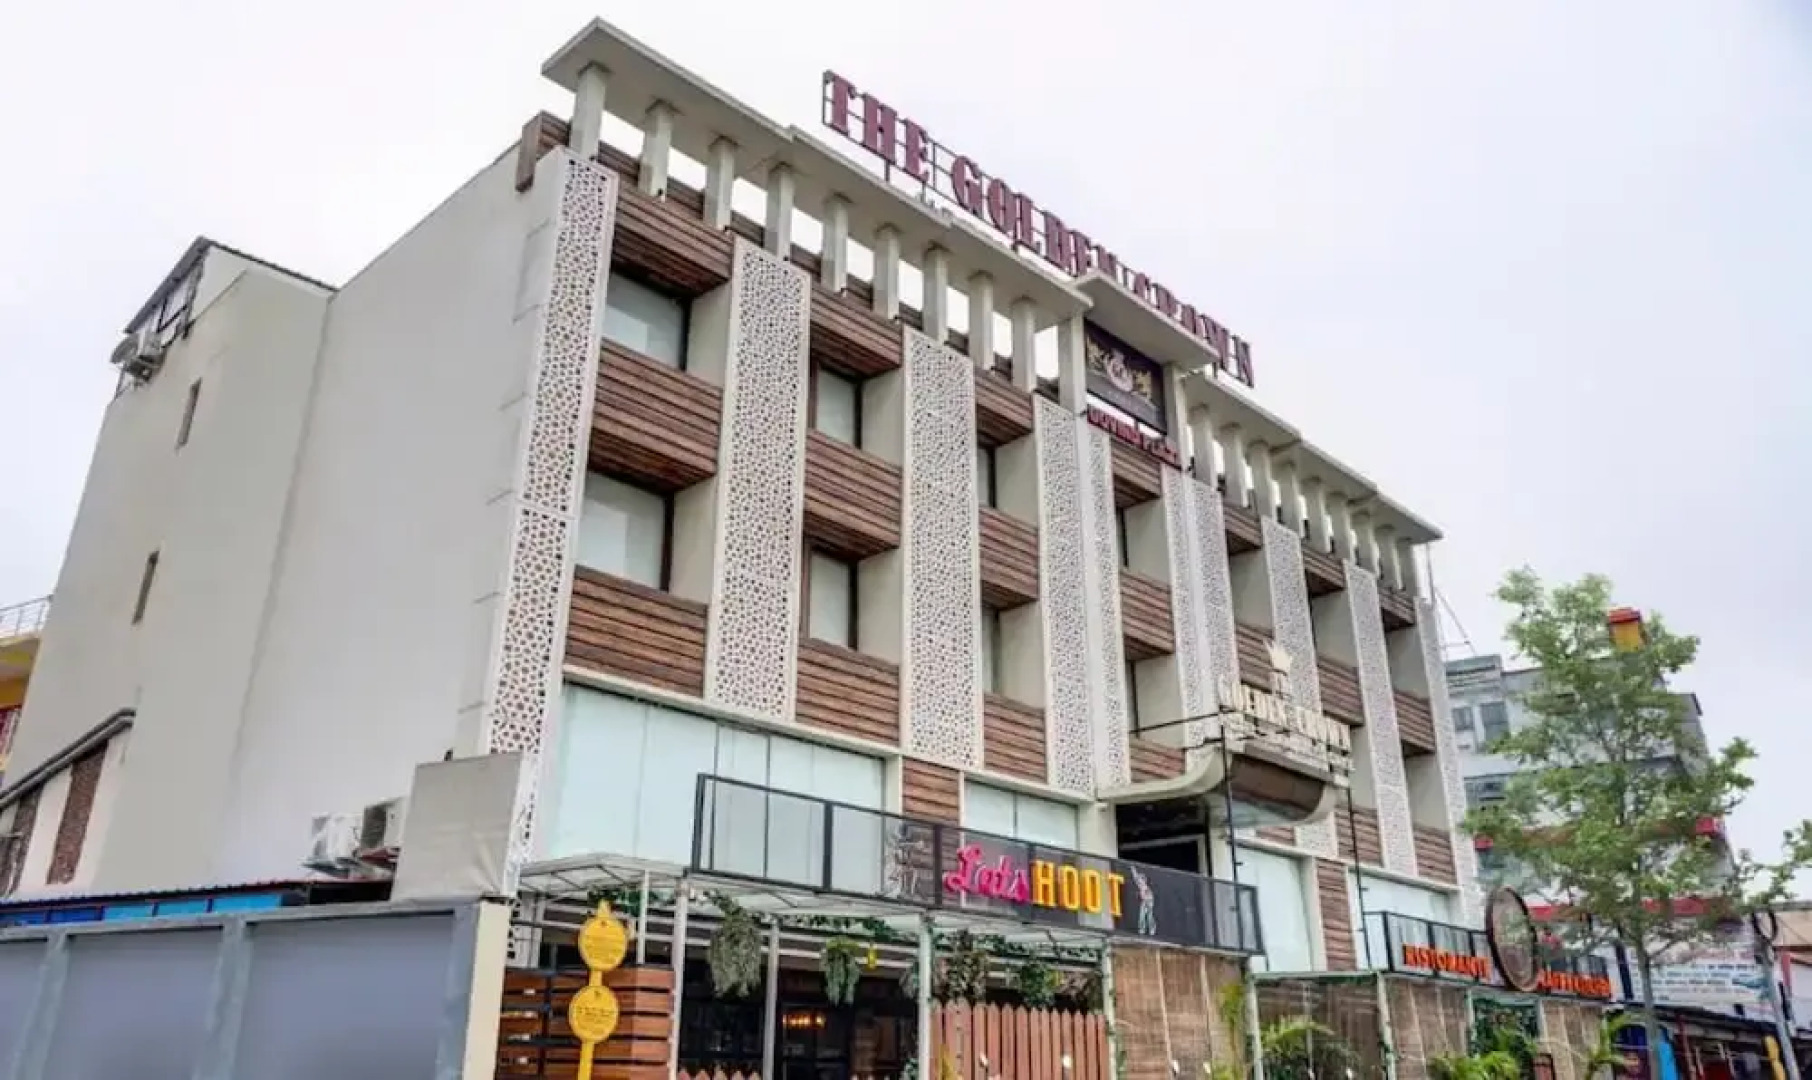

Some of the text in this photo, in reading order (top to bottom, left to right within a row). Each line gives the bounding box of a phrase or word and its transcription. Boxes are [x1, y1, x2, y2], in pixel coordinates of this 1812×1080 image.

[829, 74, 930, 183] THE
[951, 155, 1119, 278] GOLDEN
[1031, 860, 1125, 918] HOOT
